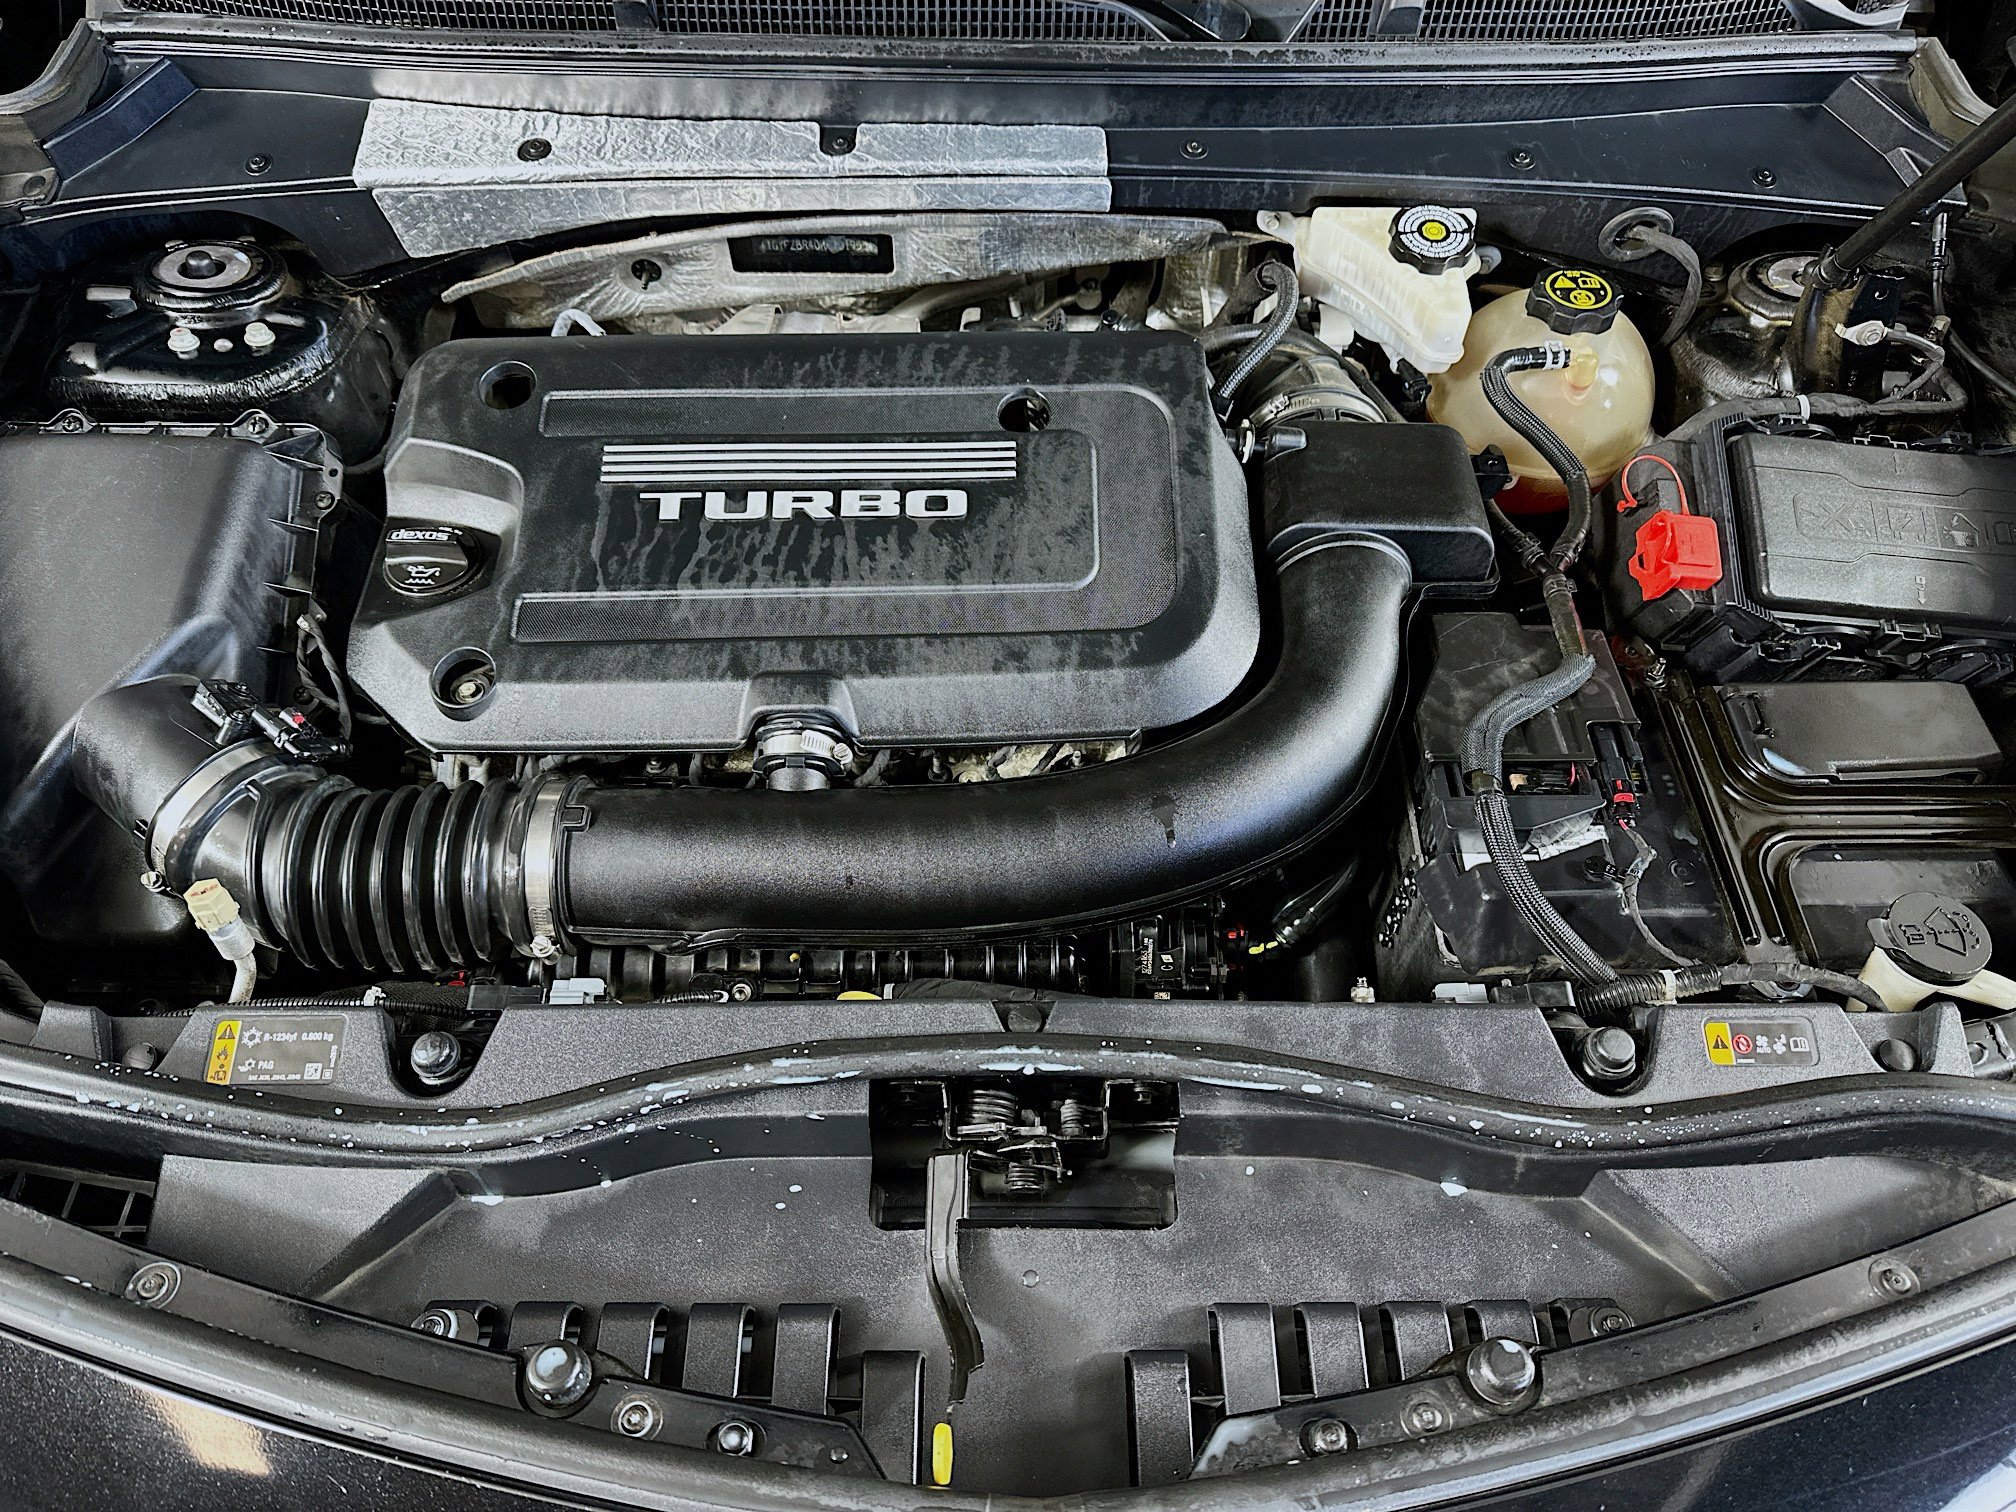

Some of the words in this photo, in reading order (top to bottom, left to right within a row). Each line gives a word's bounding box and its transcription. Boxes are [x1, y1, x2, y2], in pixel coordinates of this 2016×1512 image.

[639, 489, 967, 521] TURBO
[390, 529, 451, 541] dexos
[263, 1032, 297, 1042] R-1234yf
[257, 1061, 274, 1070] PAG
